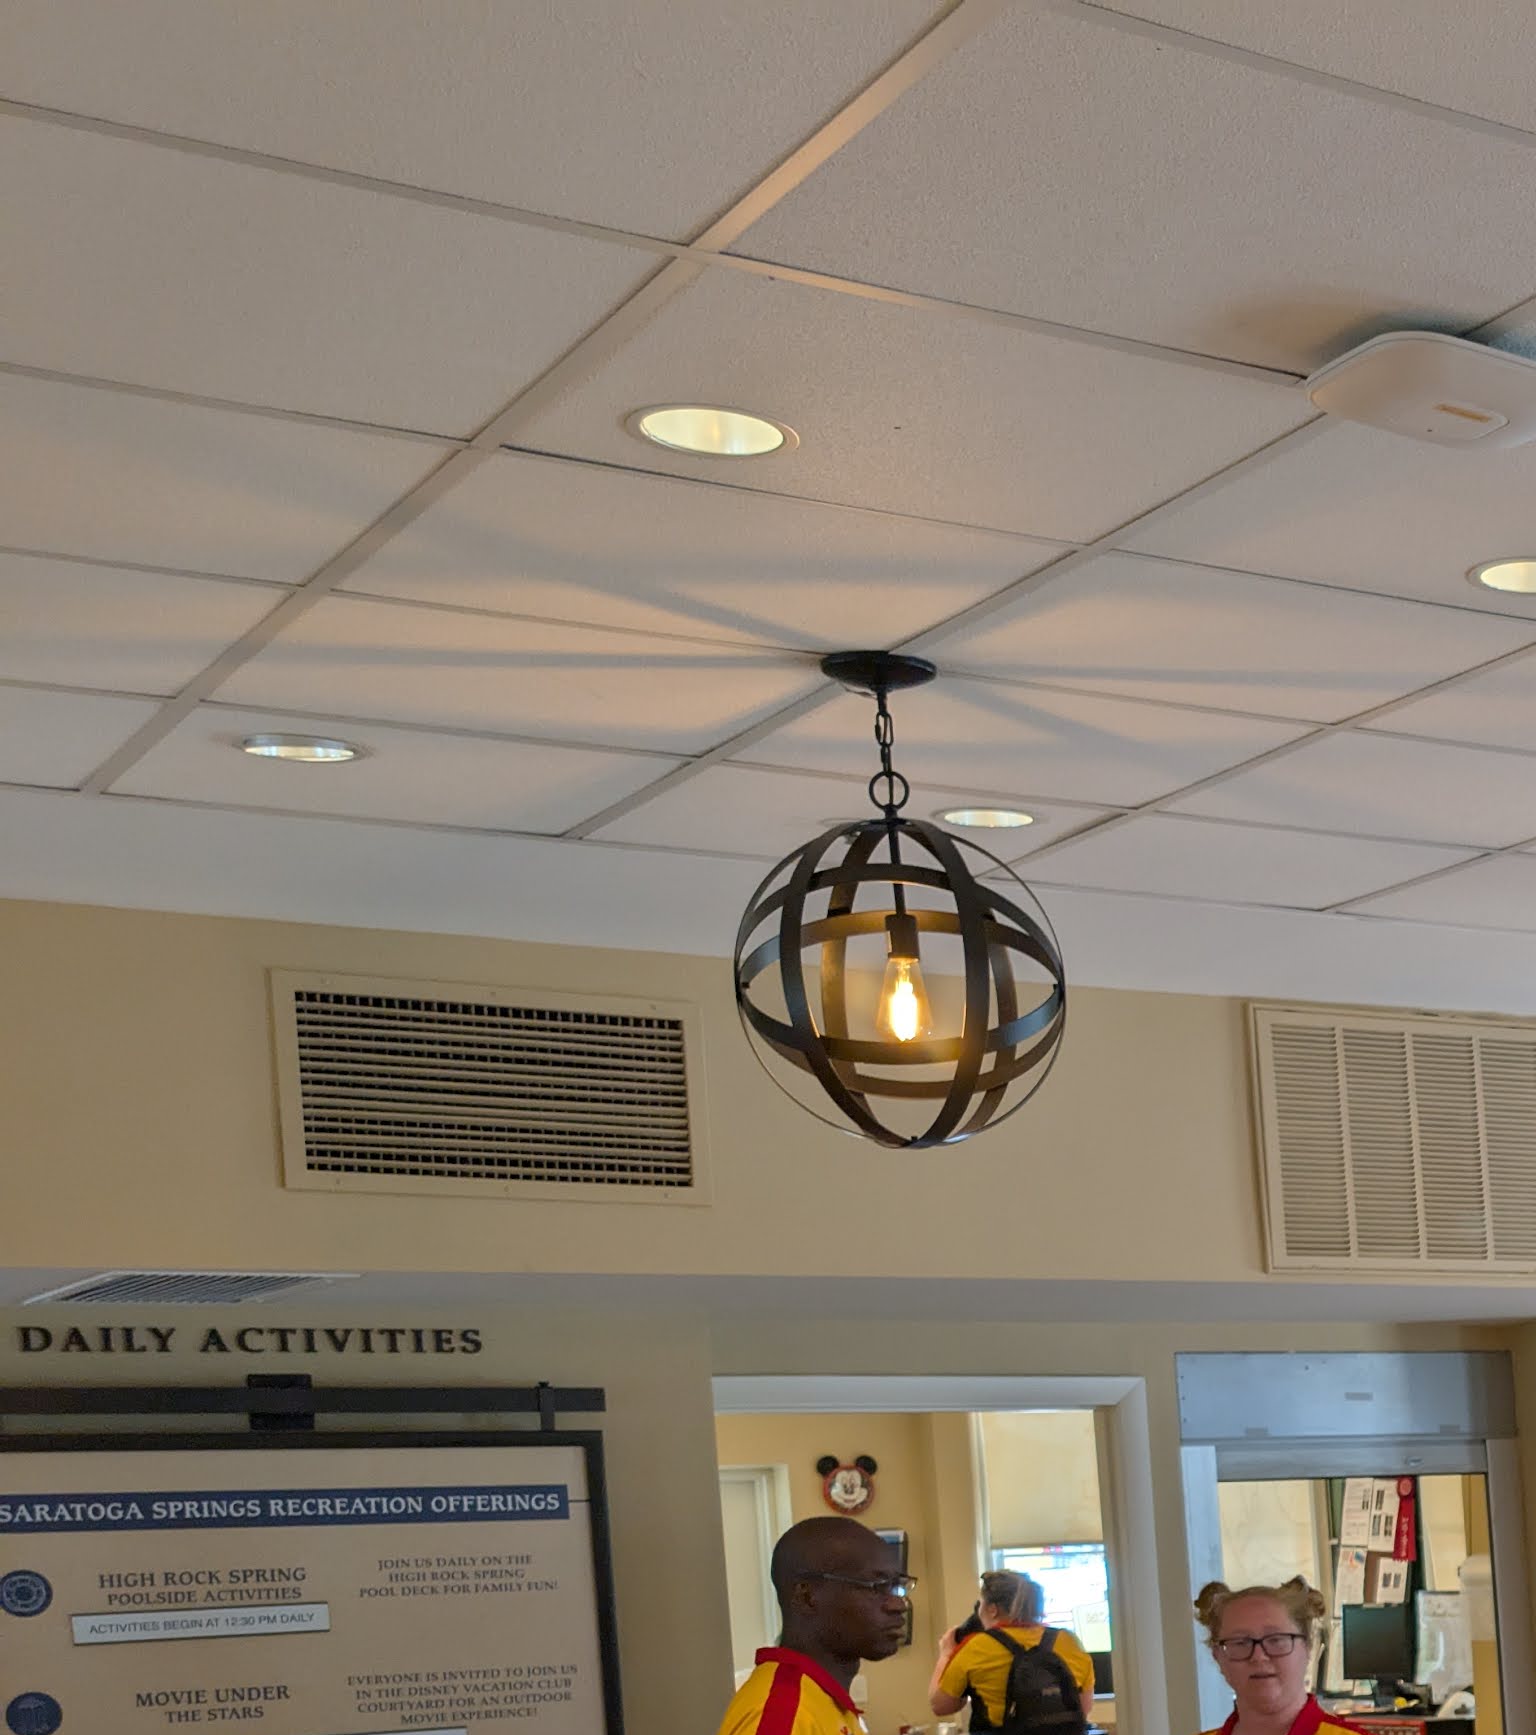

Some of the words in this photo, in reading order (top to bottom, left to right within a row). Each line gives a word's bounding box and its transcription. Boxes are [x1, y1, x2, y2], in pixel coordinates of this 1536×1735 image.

[17, 1326, 177, 1353] DAILY
[201, 1327, 483, 1354] ACTIVITIES
[0, 1502, 144, 1524] SARATOGA
[152, 1500, 262, 1520] SPRINGS
[269, 1496, 423, 1518] RECREATION
[430, 1493, 560, 1514] OFFERINGS
[378, 1558, 411, 1571] JOIN
[415, 1558, 432, 1568] US
[436, 1556, 478, 1567] DAILY
[481, 1556, 505, 1566] ON
[507, 1554, 533, 1565] THE
[99, 1572, 155, 1589] HIGH
[163, 1570, 221, 1586] ROCK
[228, 1567, 307, 1585] SPRING
[389, 1571, 427, 1583] HIGH
[431, 1570, 469, 1582] ROCK
[474, 1568, 525, 1580] SPRING
[107, 1589, 198, 1606] POOLSIDE
[204, 1586, 303, 1602] ACTIVITIES
[359, 1586, 398, 1598] POOL
[401, 1585, 439, 1597] DECK
[443, 1584, 471, 1595] FOR
[474, 1581, 523, 1594] FAMILY
[89, 1619, 160, 1635] ACTIVITIES
[163, 1618, 203, 1632] BEGIN
[206, 1616, 220, 1629] AT
[224, 1614, 256, 1628] 12:30
[258, 1613, 278, 1626] PM
[280, 1612, 315, 1624] DAILY
[347, 1672, 422, 1686] EVERYONE
[426, 1671, 439, 1683] IS
[442, 1668, 501, 1681] INVITED
[505, 1667, 523, 1678] TO
[527, 1666, 557, 1678] JOIN
[561, 1664, 578, 1675] US
[136, 1689, 208, 1708] MOVIE
[214, 1685, 290, 1704] UNDER
[356, 1689, 371, 1700] IN
[376, 1687, 403, 1699] THE
[407, 1684, 459, 1697] DISNEY
[463, 1680, 534, 1694] VACATION
[537, 1678, 572, 1690] CLUB
[357, 1699, 445, 1714] COURTYARD
[449, 1697, 476, 1708] FOR
[481, 1695, 500, 1706] AN
[503, 1692, 573, 1705] OUTDOOR
[165, 1709, 202, 1724] THE
[207, 1706, 264, 1722] STARS
[401, 1712, 448, 1726] MOVIE
[452, 1707, 538, 1722] EXPERIENCE!
